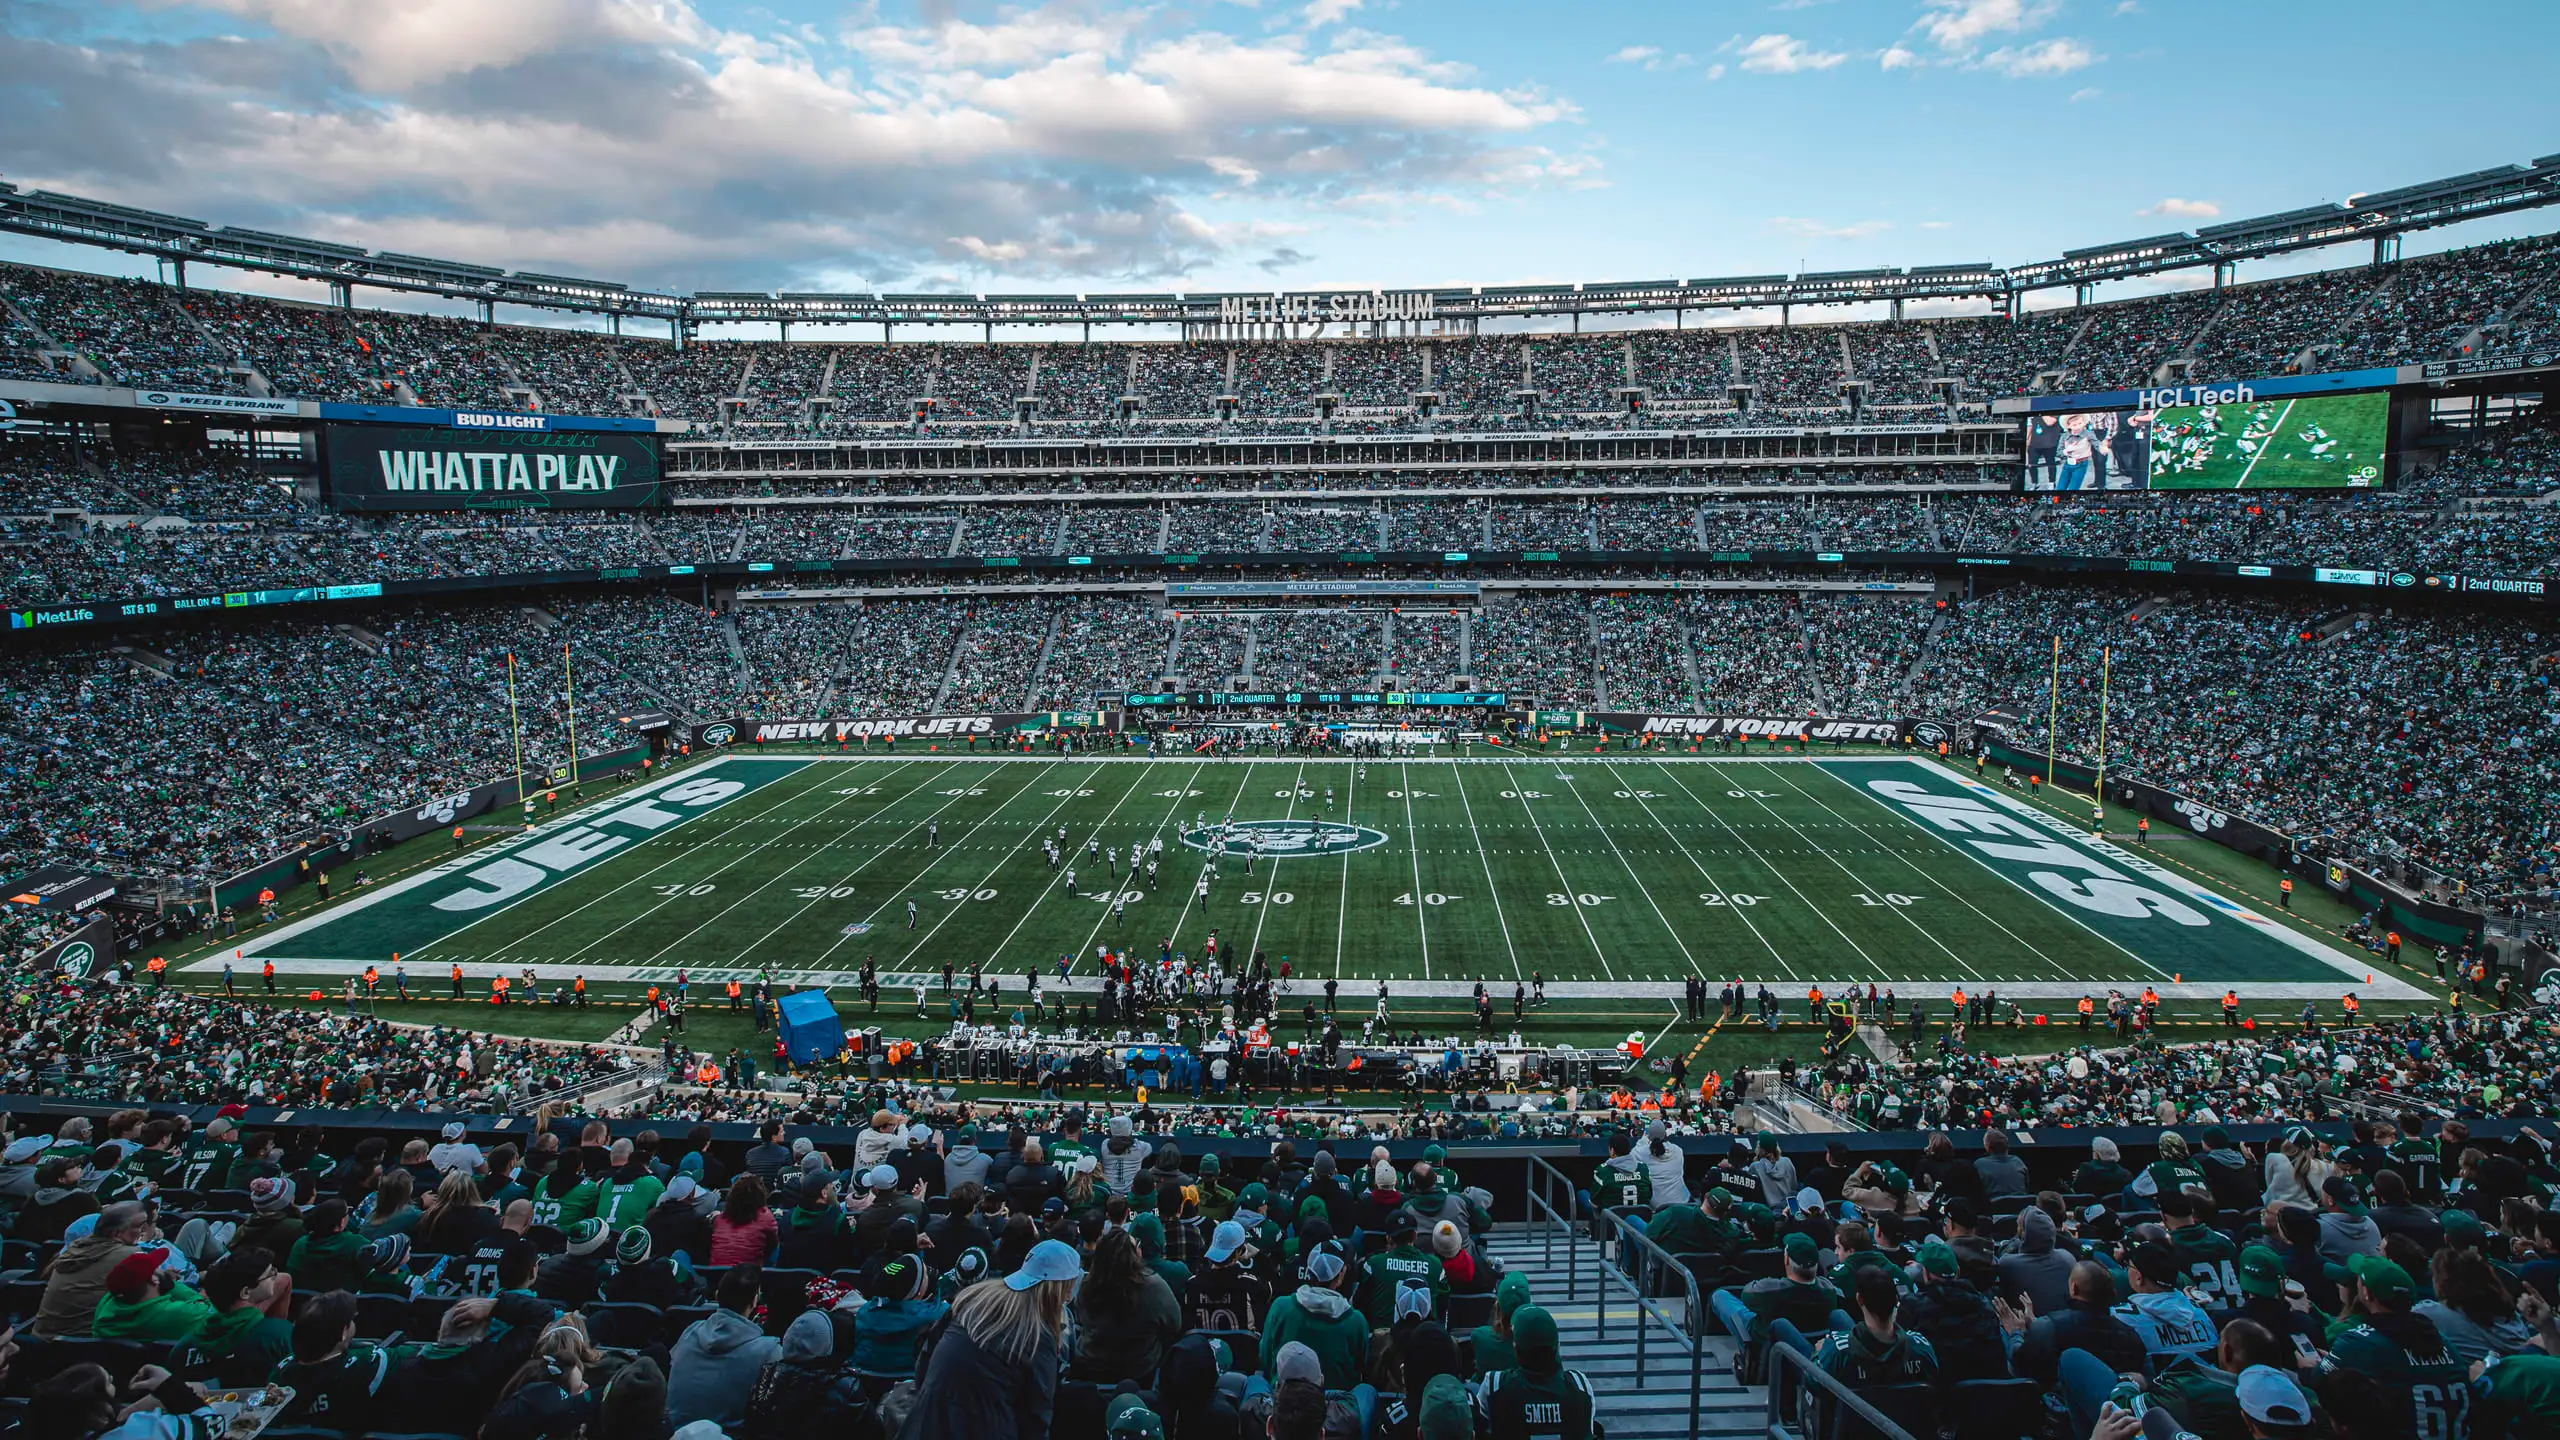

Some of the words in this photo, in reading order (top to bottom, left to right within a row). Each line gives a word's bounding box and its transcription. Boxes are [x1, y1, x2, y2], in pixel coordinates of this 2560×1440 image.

[1221, 295, 1320, 323] METLIFE
[1329, 293, 1434, 321] STADIUM
[2426, 369, 2448, 377] Help?
[180, 396, 224, 405] WEEB
[224, 400, 285, 410] EWBANK
[2139, 383, 2254, 410] HCLTech
[456, 413, 495, 426] BUD
[496, 415, 546, 428] LIGHT
[379, 450, 532, 490] WHATTA
[537, 454, 618, 490] PLAY
[983, 558, 999, 566] FIRST
[1000, 558, 1018, 566] DOWN
[1165, 555, 1180, 563] FIRST
[1181, 554, 1198, 563] DOWN
[1523, 552, 1539, 560] FIRST
[1540, 552, 1558, 560] DOWN
[1713, 552, 1729, 561] FIRST
[1730, 552, 1749, 561] DOWN
[2129, 560, 2149, 571] FIRST
[2150, 561, 2172, 572] DOWN
[2449, 576, 2457, 588] 3
[2469, 579, 2490, 590] 2nd
[2492, 580, 2544, 593] QUARTER
[174, 599, 196, 608] BALL
[197, 598, 209, 607] ON
[211, 597, 221, 605] 42
[254, 591, 266, 603] 14
[37, 608, 94, 624] MetLife
[121, 605, 136, 615] 1ST
[137, 604, 144, 614] &
[146, 603, 157, 613] 10
[1198, 695, 1203, 703] 3
[1230, 695, 1243, 703] 2nd
[1244, 695, 1275, 703] QUARTER
[1285, 693, 1301, 703] 4:30
[1351, 694, 1364, 702] BALL
[1364, 694, 1371, 702] ON
[1372, 694, 1379, 702] 42
[1421, 694, 1430, 703] 14
[757, 719, 832, 740] NEW
[837, 718, 918, 736] YORK
[917, 717, 993, 734] JETS
[1642, 717, 1719, 733] NEW
[1722, 718, 1810, 736] YORK
[1811, 719, 1897, 740] JETS
[555, 768, 566, 779] 30
[417, 792, 470, 820] JETS
[2174, 799, 2227, 828] JETS
[432, 863, 461, 872] IT
[463, 833, 537, 859] TAKES
[539, 817, 577, 830] ALL
[577, 806, 601, 816] OF
[602, 796, 631, 805] US
[2017, 809, 2090, 840] CRUCIAL
[2090, 843, 2162, 871] CATCH
[431, 777, 746, 911] JETS
[1867, 780, 2210, 926] JETS
[2330, 867, 2342, 882] 30
[657, 884, 716, 896] 10
[804, 886, 855, 899] 20
[943, 887, 998, 900] 30
[1090, 891, 1144, 902] 40
[75, 895, 96, 911] METLIFE
[95, 887, 116, 903] STADIUM
[1240, 891, 1294, 904] 50
[1393, 892, 1446, 905] 40
[1546, 893, 1601, 906] 30
[1699, 893, 1756, 906] 20
[1851, 892, 1912, 906] 10
[64, 951, 88, 973] JETS
[193, 1150, 218, 1160] WILSON
[1054, 1148, 1080, 1158] DAWKINS
[2409, 1154, 2435, 1162] GARDNER
[128, 1161, 145, 1171] HALL
[183, 1162, 211, 1190] 17
[1721, 1172, 1756, 1189] McNABB
[2418, 1164, 2424, 1188] 1
[531, 1201, 561, 1225] 62
[608, 1195, 622, 1223] 1
[475, 1247, 504, 1258] ADAMS
[1386, 1258, 1429, 1274] RODGERS
[463, 1264, 499, 1297] 33
[2187, 1259, 2243, 1310] 24
[1196, 1308, 1239, 1330] 10
[1525, 1403, 1562, 1423] SMITH
[2411, 1383, 2471, 1440] 62
